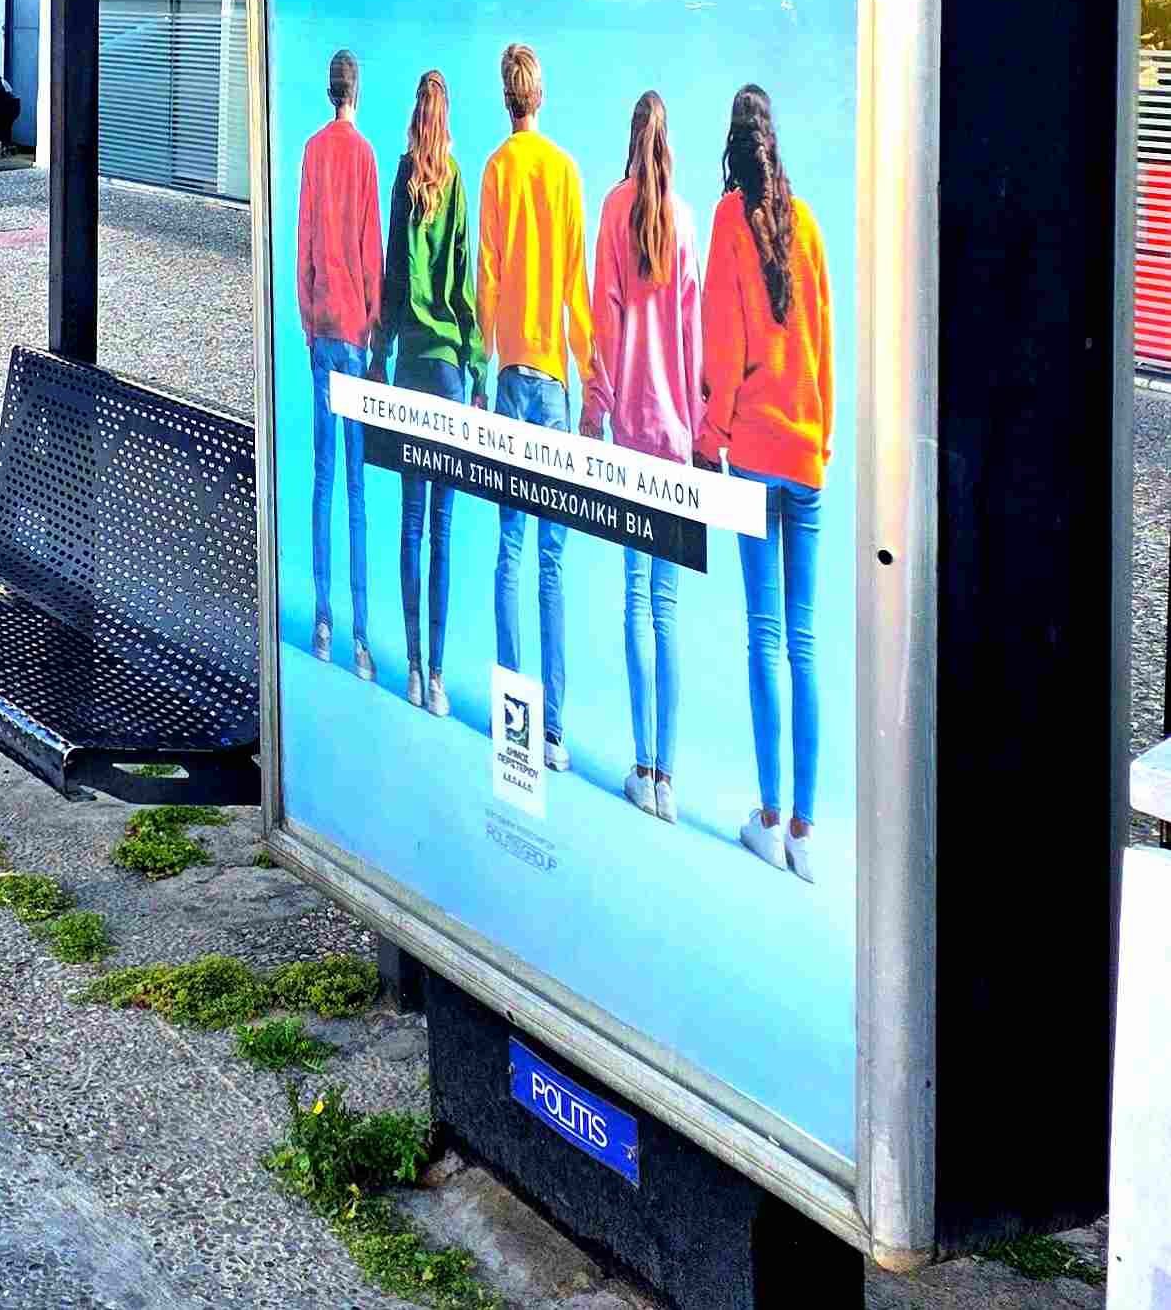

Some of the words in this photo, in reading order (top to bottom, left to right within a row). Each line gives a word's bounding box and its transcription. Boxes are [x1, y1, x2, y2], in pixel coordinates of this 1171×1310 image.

[361, 394, 455, 436] ΣΤΕΚΟΜΑΣΤΕ
[462, 422, 471, 442] Ο
[478, 426, 516, 455] ΕΝΑΣ
[524, 442, 575, 475] ΔΙΠΛΑ
[586, 456, 627, 488] ΣΤΟΝ
[637, 474, 700, 510] ΑΛΛΟΝ
[403, 444, 463, 477] ΕΝΑΝΤΙΑ
[469, 464, 504, 492] ΣΤΗΝ
[510, 475, 618, 529] ΕΝΔΟΣΧΟΛΙΚΗ
[626, 512, 654, 542] ΒΙΑ
[532, 1072, 608, 1147] POLITIS
